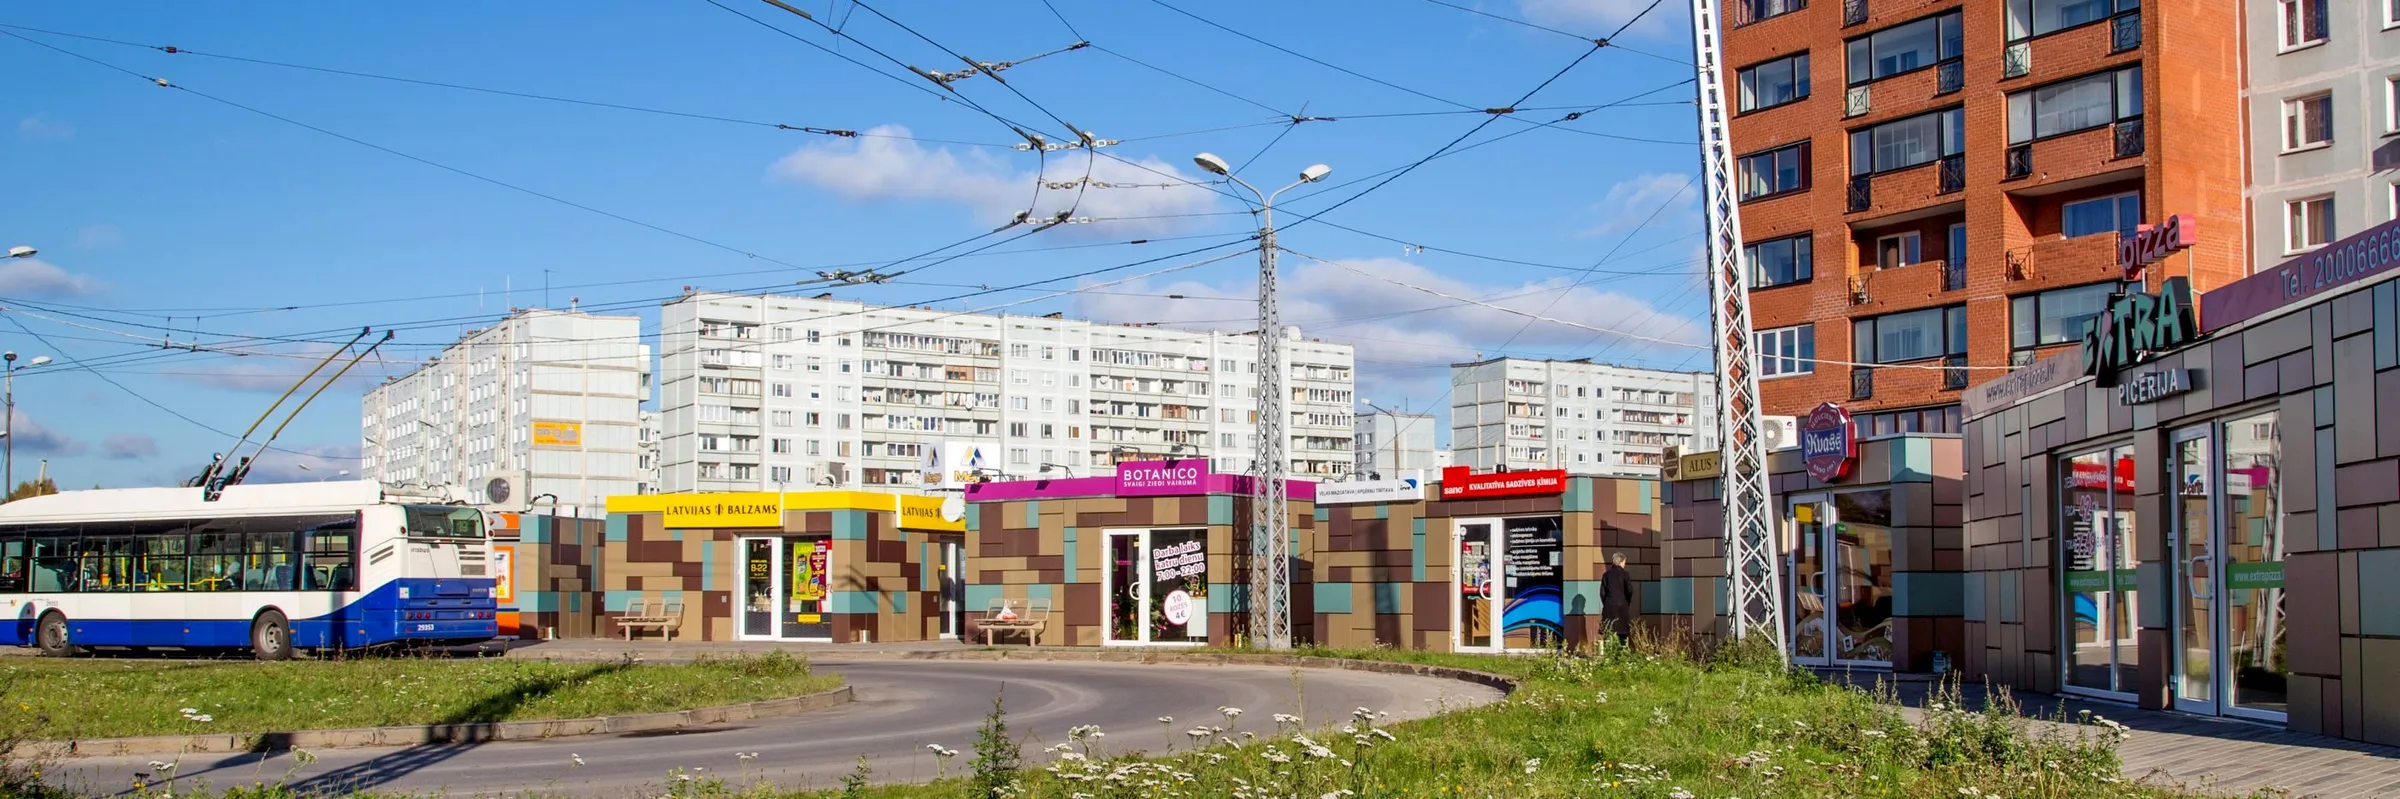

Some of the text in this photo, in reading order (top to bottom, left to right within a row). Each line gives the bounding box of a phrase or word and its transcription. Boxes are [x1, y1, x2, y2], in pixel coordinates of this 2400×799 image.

[2121, 214, 2184, 280] pizza
[2280, 226, 2400, 300] Tel. 20006666
[2082, 277, 2184, 380] EXTRA
[2118, 368, 2179, 406] PICĒRIJA
[1807, 432, 1842, 455] Kvass
[1688, 457, 1713, 473] ALUS
[1123, 467, 1198, 481] BOTANICO
[1444, 487, 1464, 495] sano
[1469, 480, 1505, 491] KVALITATĪVA
[1506, 478, 1536, 488] SADZĪVES
[666, 504, 778, 516] LATVIJAS BALZAMS
[902, 506, 934, 518] LATVIJAS
[1153, 540, 1201, 560] Darba laiks
[1154, 552, 1205, 571] katru dienu
[1180, 562, 1206, 577] 22:00
[2234, 569, 2284, 583] www.extrapizza.l
[1172, 594, 1182, 604] 10
[417, 623, 435, 632] 29353
